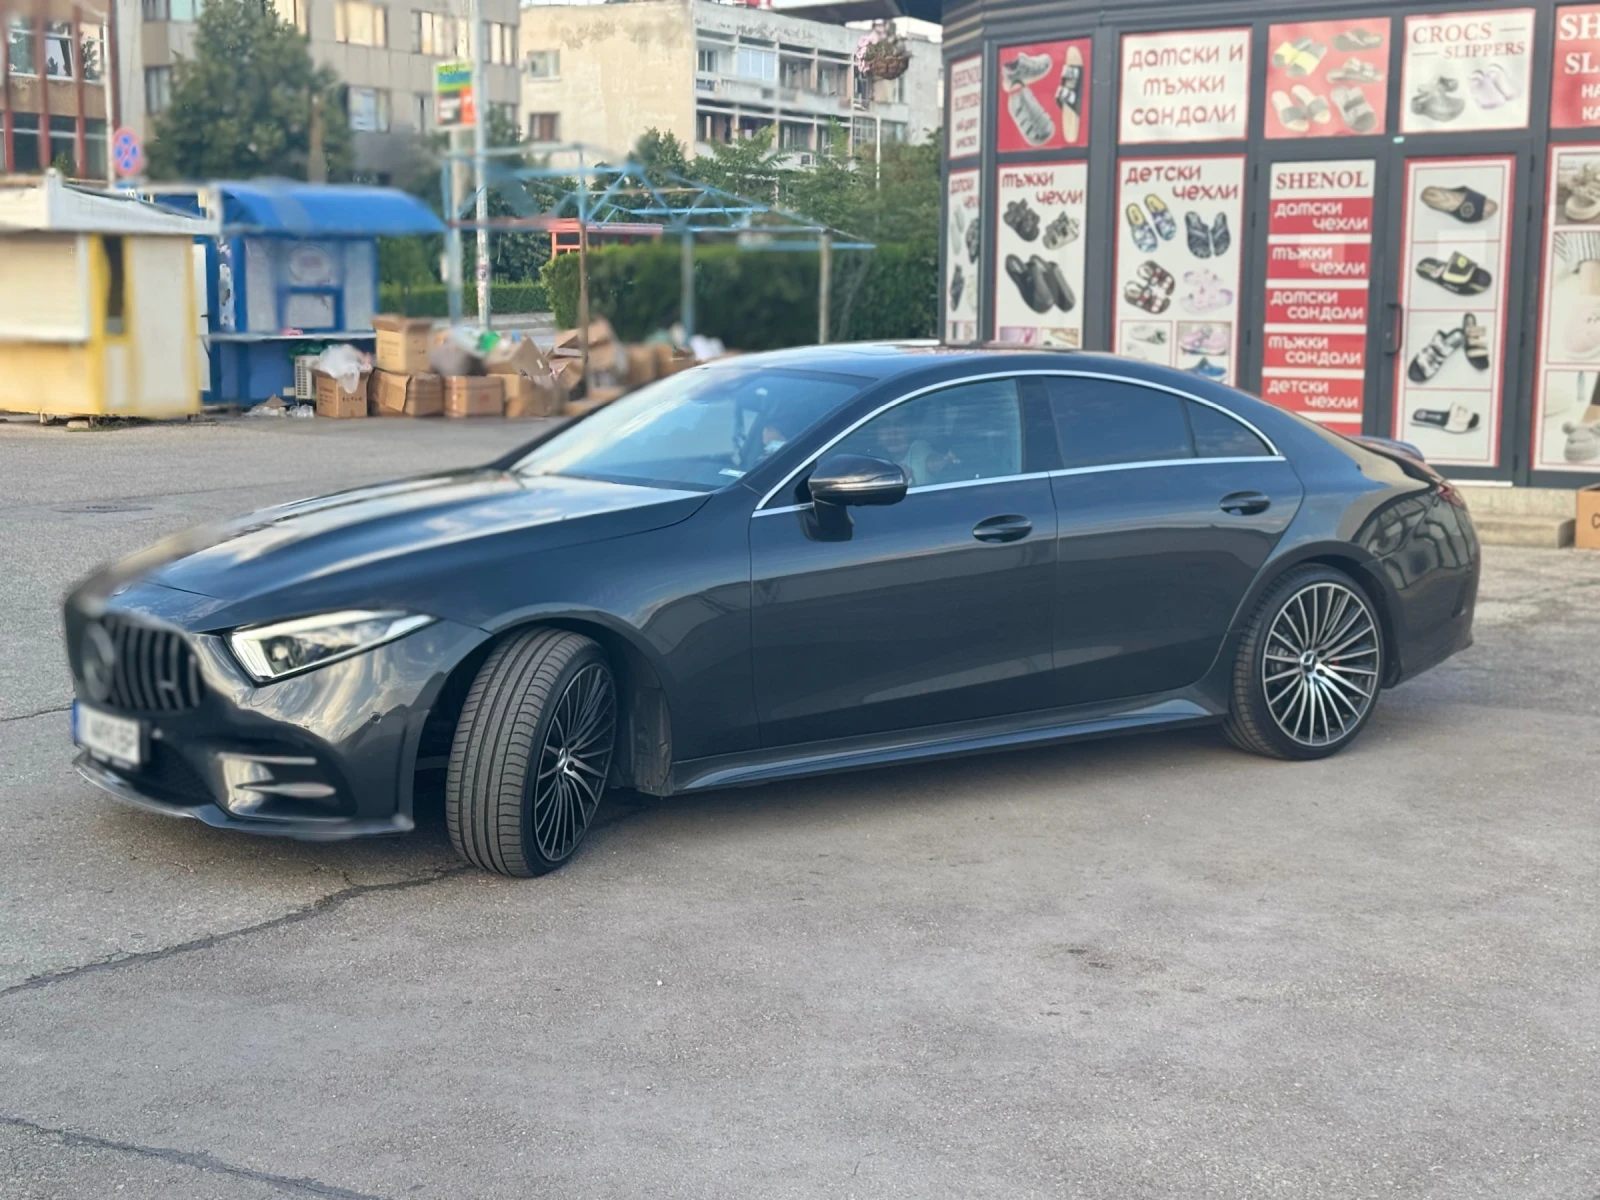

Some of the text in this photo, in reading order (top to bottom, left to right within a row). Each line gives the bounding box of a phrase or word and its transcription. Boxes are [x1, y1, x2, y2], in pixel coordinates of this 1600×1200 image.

[1413, 22, 1492, 44] CROCS
[1229, 44, 1243, 62] и
[1444, 41, 1525, 58] SLIPPERS
[1131, 104, 1236, 128] сандали
[1125, 165, 1201, 184] детски
[1275, 170, 1369, 190] SHENOL
[1036, 190, 1083, 205] чехли
[1172, 184, 1238, 201] чехли
[1312, 217, 1368, 231] чехли
[1310, 262, 1366, 275] чехли
[1287, 306, 1364, 321] сандали
[1285, 351, 1361, 366] сандали
[1267, 379, 1329, 395] детски
[1304, 396, 1359, 408] чехли
